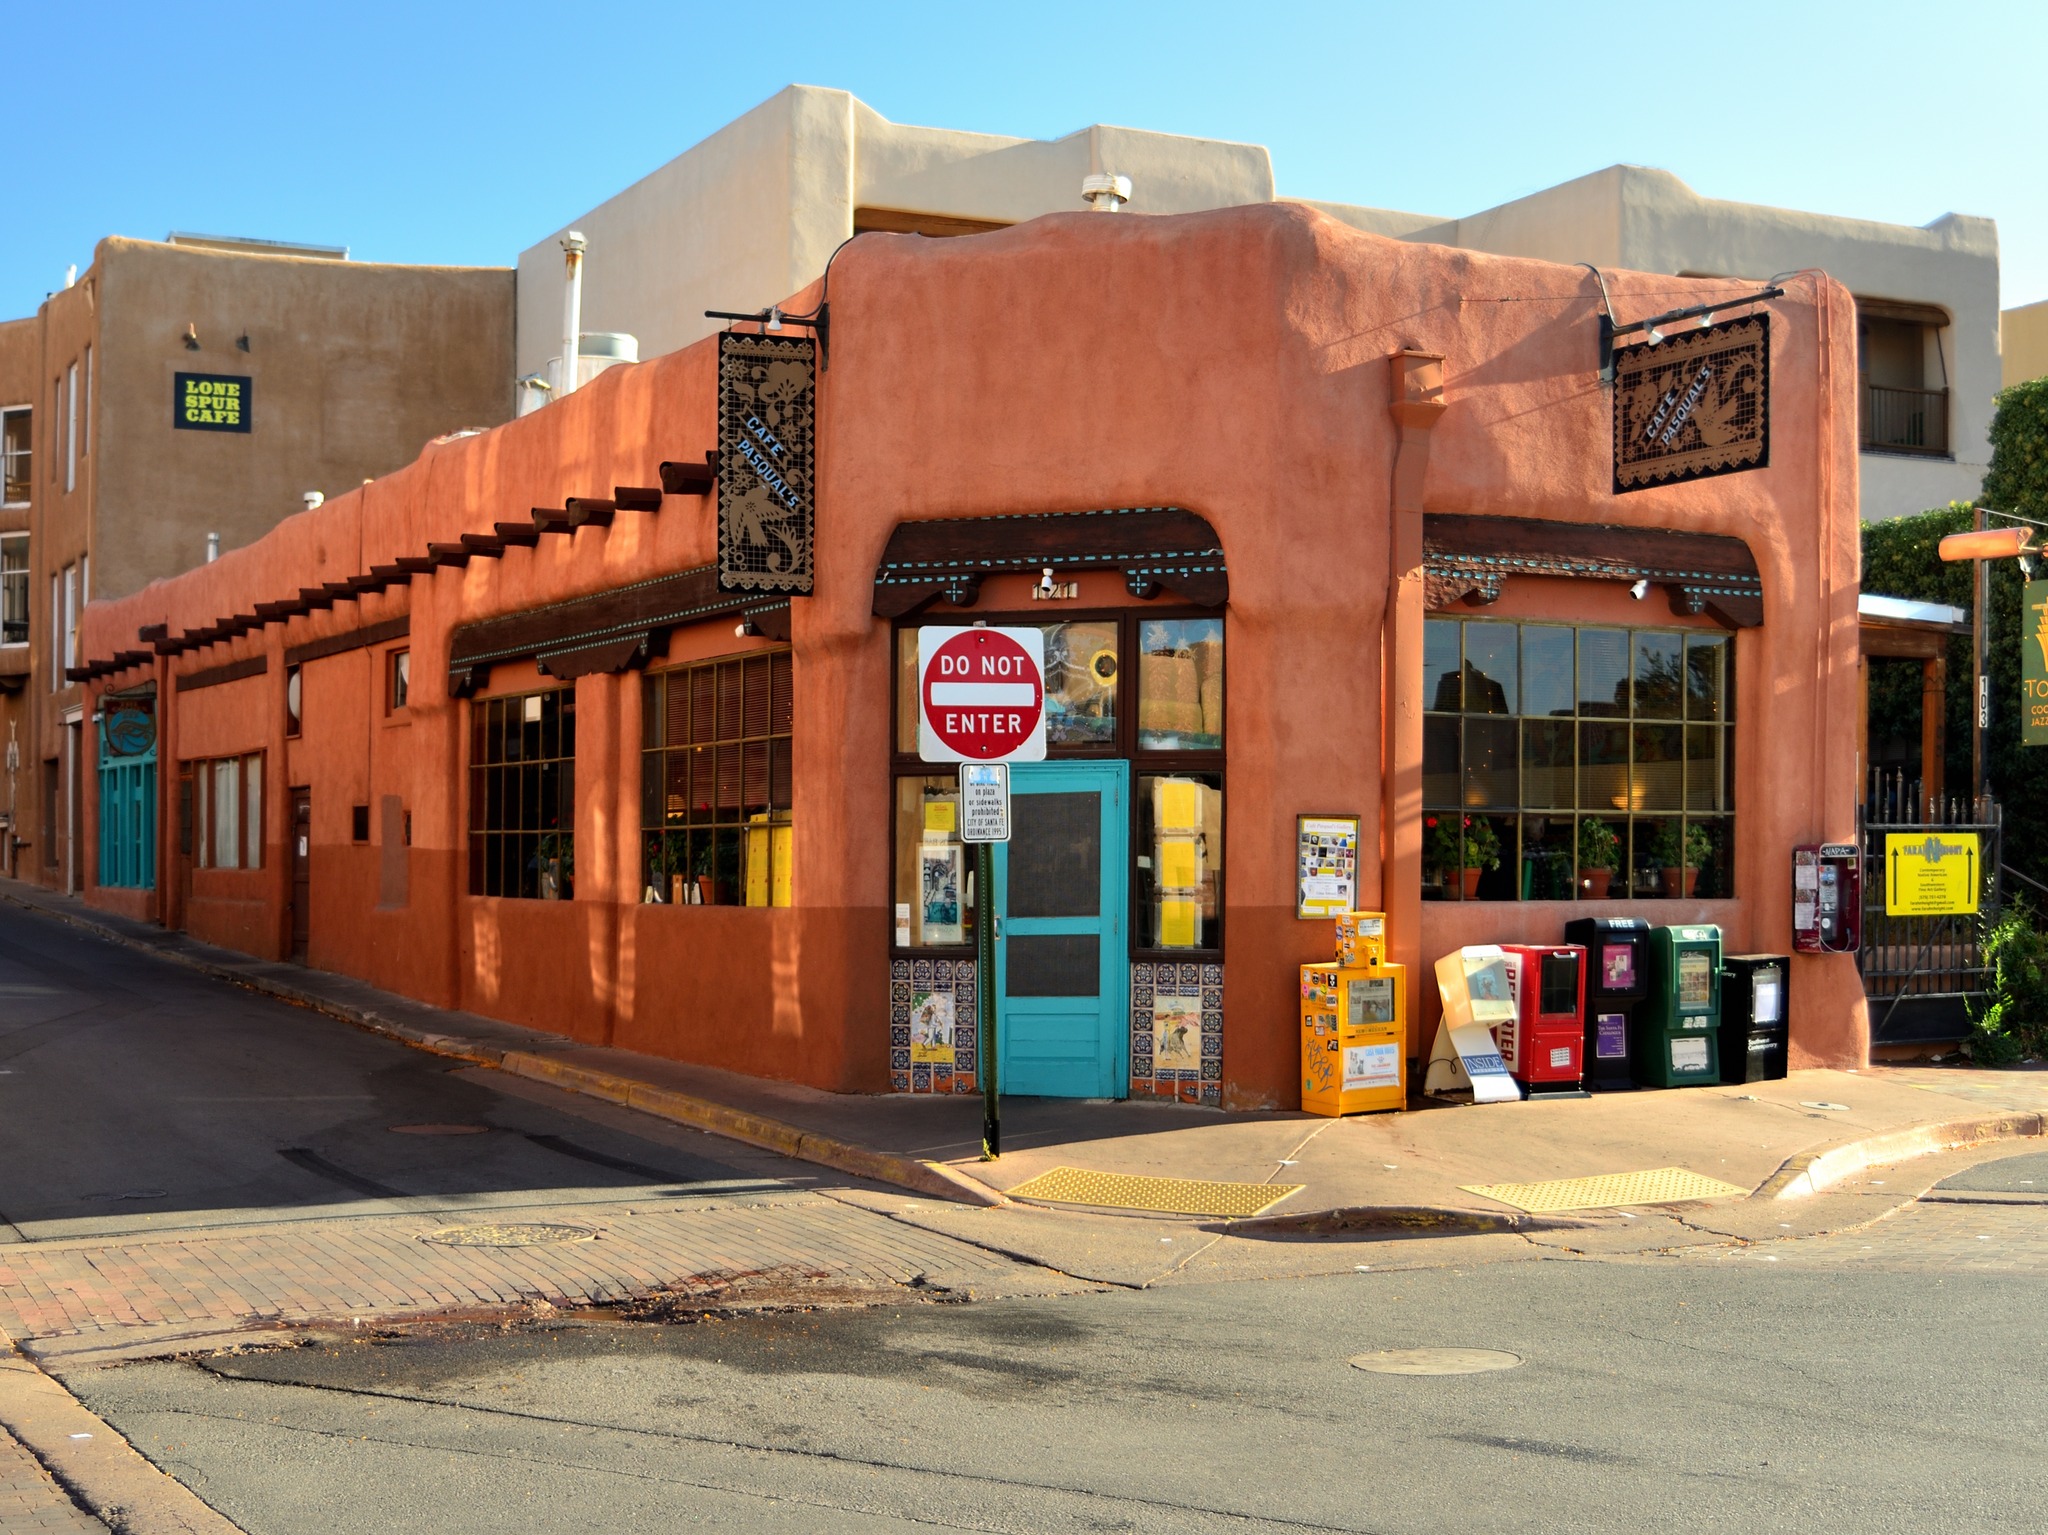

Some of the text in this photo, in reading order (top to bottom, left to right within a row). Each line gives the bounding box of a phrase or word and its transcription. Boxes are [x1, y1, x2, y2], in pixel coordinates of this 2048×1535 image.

[186, 381, 240, 396] LONE
[185, 395, 240, 410] SPUR
[1661, 366, 1710, 445] PASQUAL'S
[186, 409, 240, 424] CAFE
[1647, 392, 1675, 438] CAFE
[747, 416, 784, 457] CAFE
[737, 439, 799, 507] PASQUAL'S
[1033, 582, 1071, 600] 121
[941, 655, 1025, 676] DO NOT
[946, 713, 1021, 734] ENTER
[983, 787, 995, 796] plaza
[967, 818, 1004, 827] CITY OF SANTA FE
[967, 827, 991, 836] ORDINANCE
[1608, 919, 1635, 928] FREE
[1464, 1056, 1503, 1073] INSIDE
